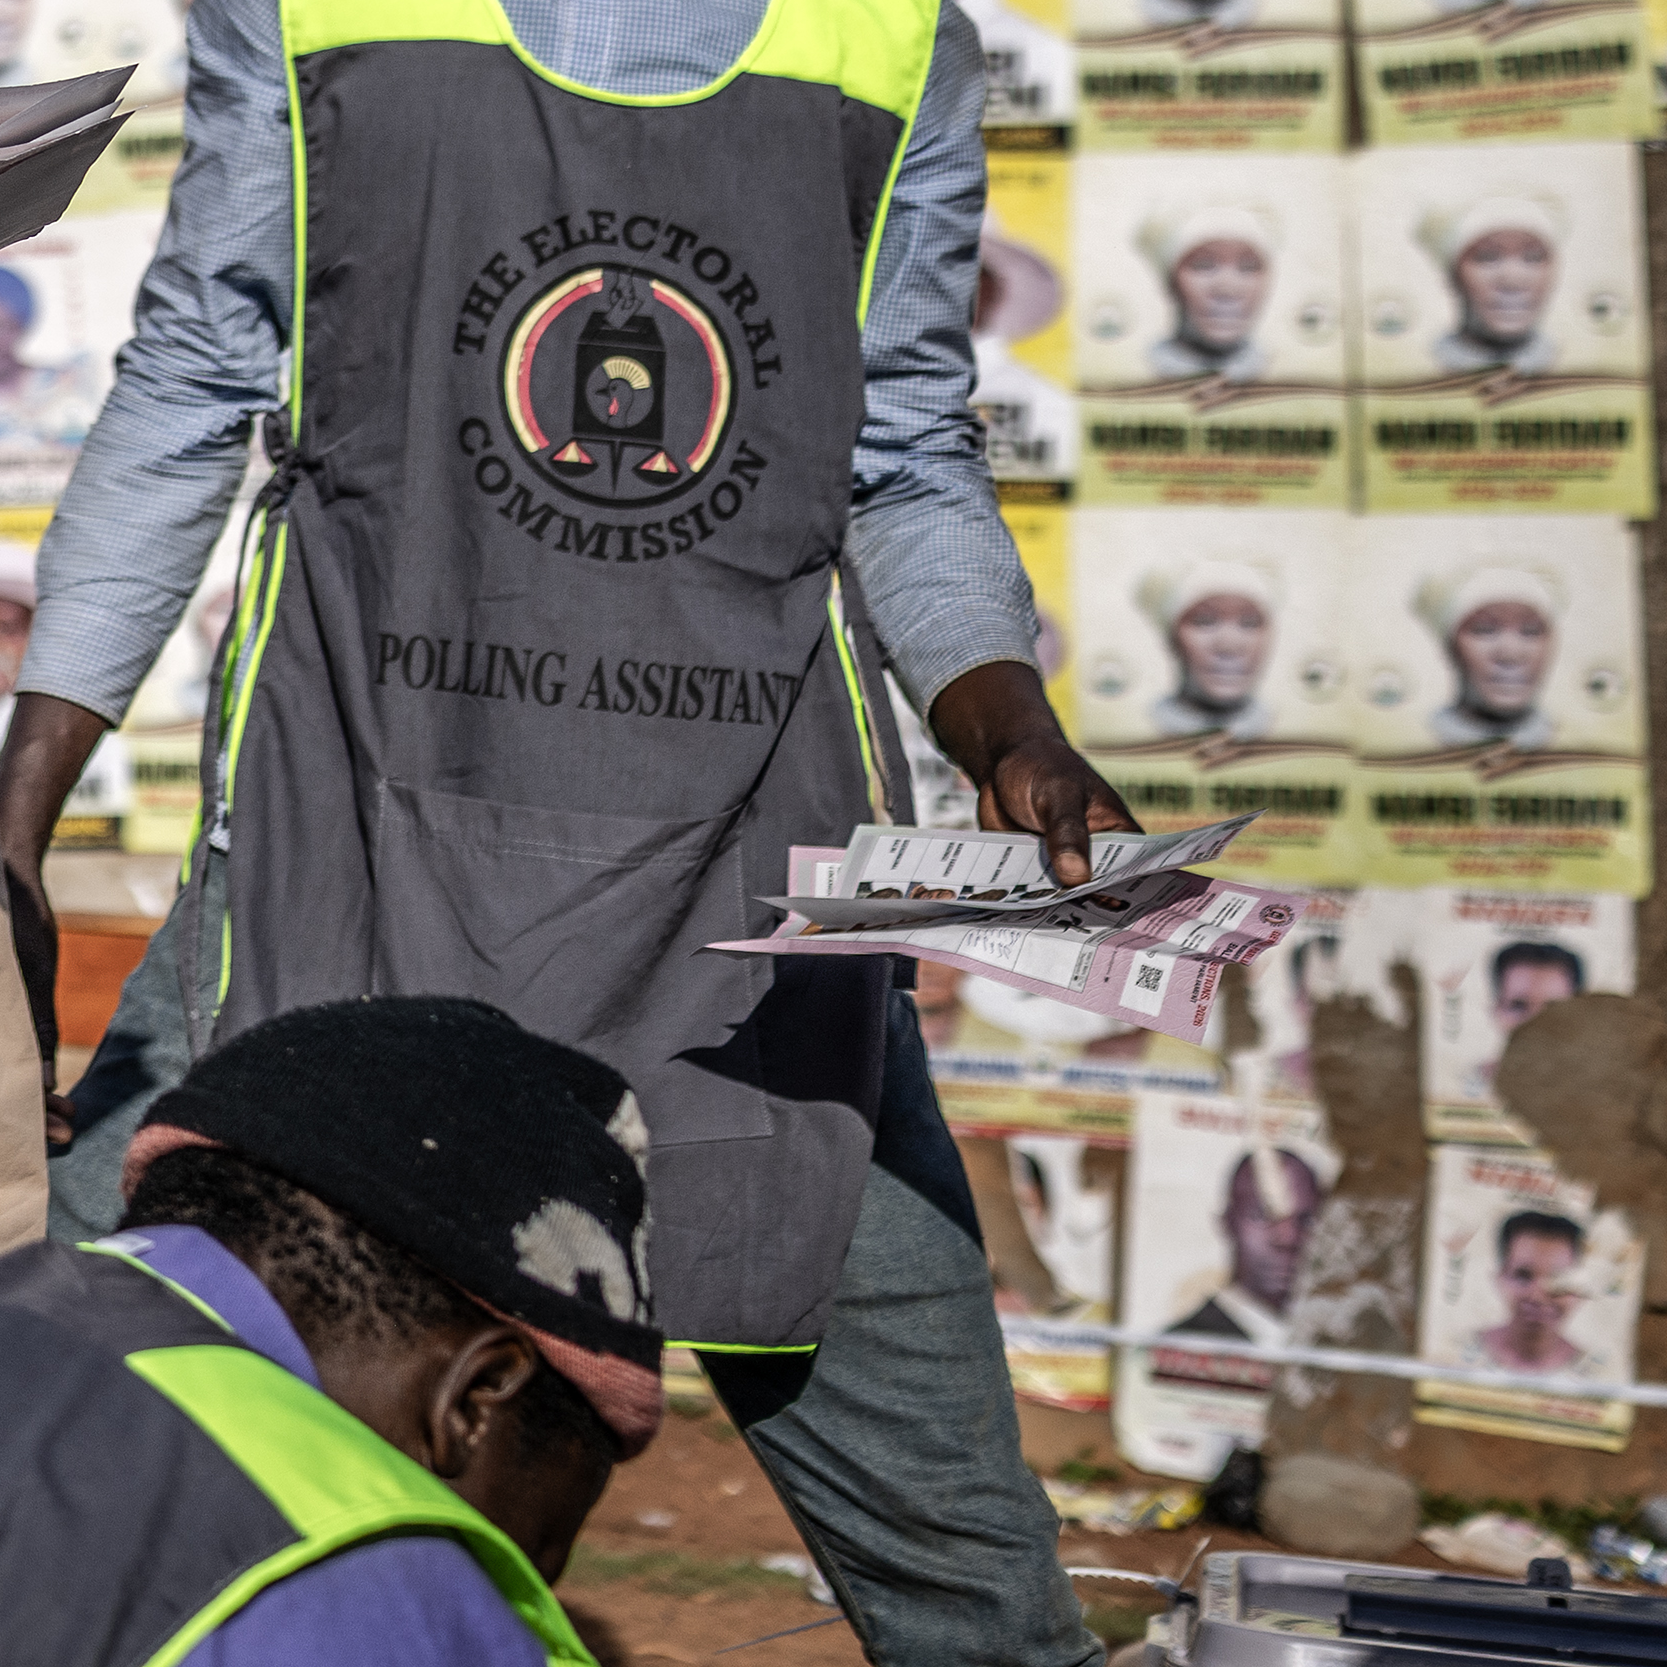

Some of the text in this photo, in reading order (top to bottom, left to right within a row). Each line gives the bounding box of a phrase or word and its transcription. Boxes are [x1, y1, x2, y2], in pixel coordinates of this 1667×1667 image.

[453, 209, 783, 390] THE ELECTORAL
[458, 416, 769, 564] COMMISSION
[373, 632, 803, 728] POLLING ASSISTANT
